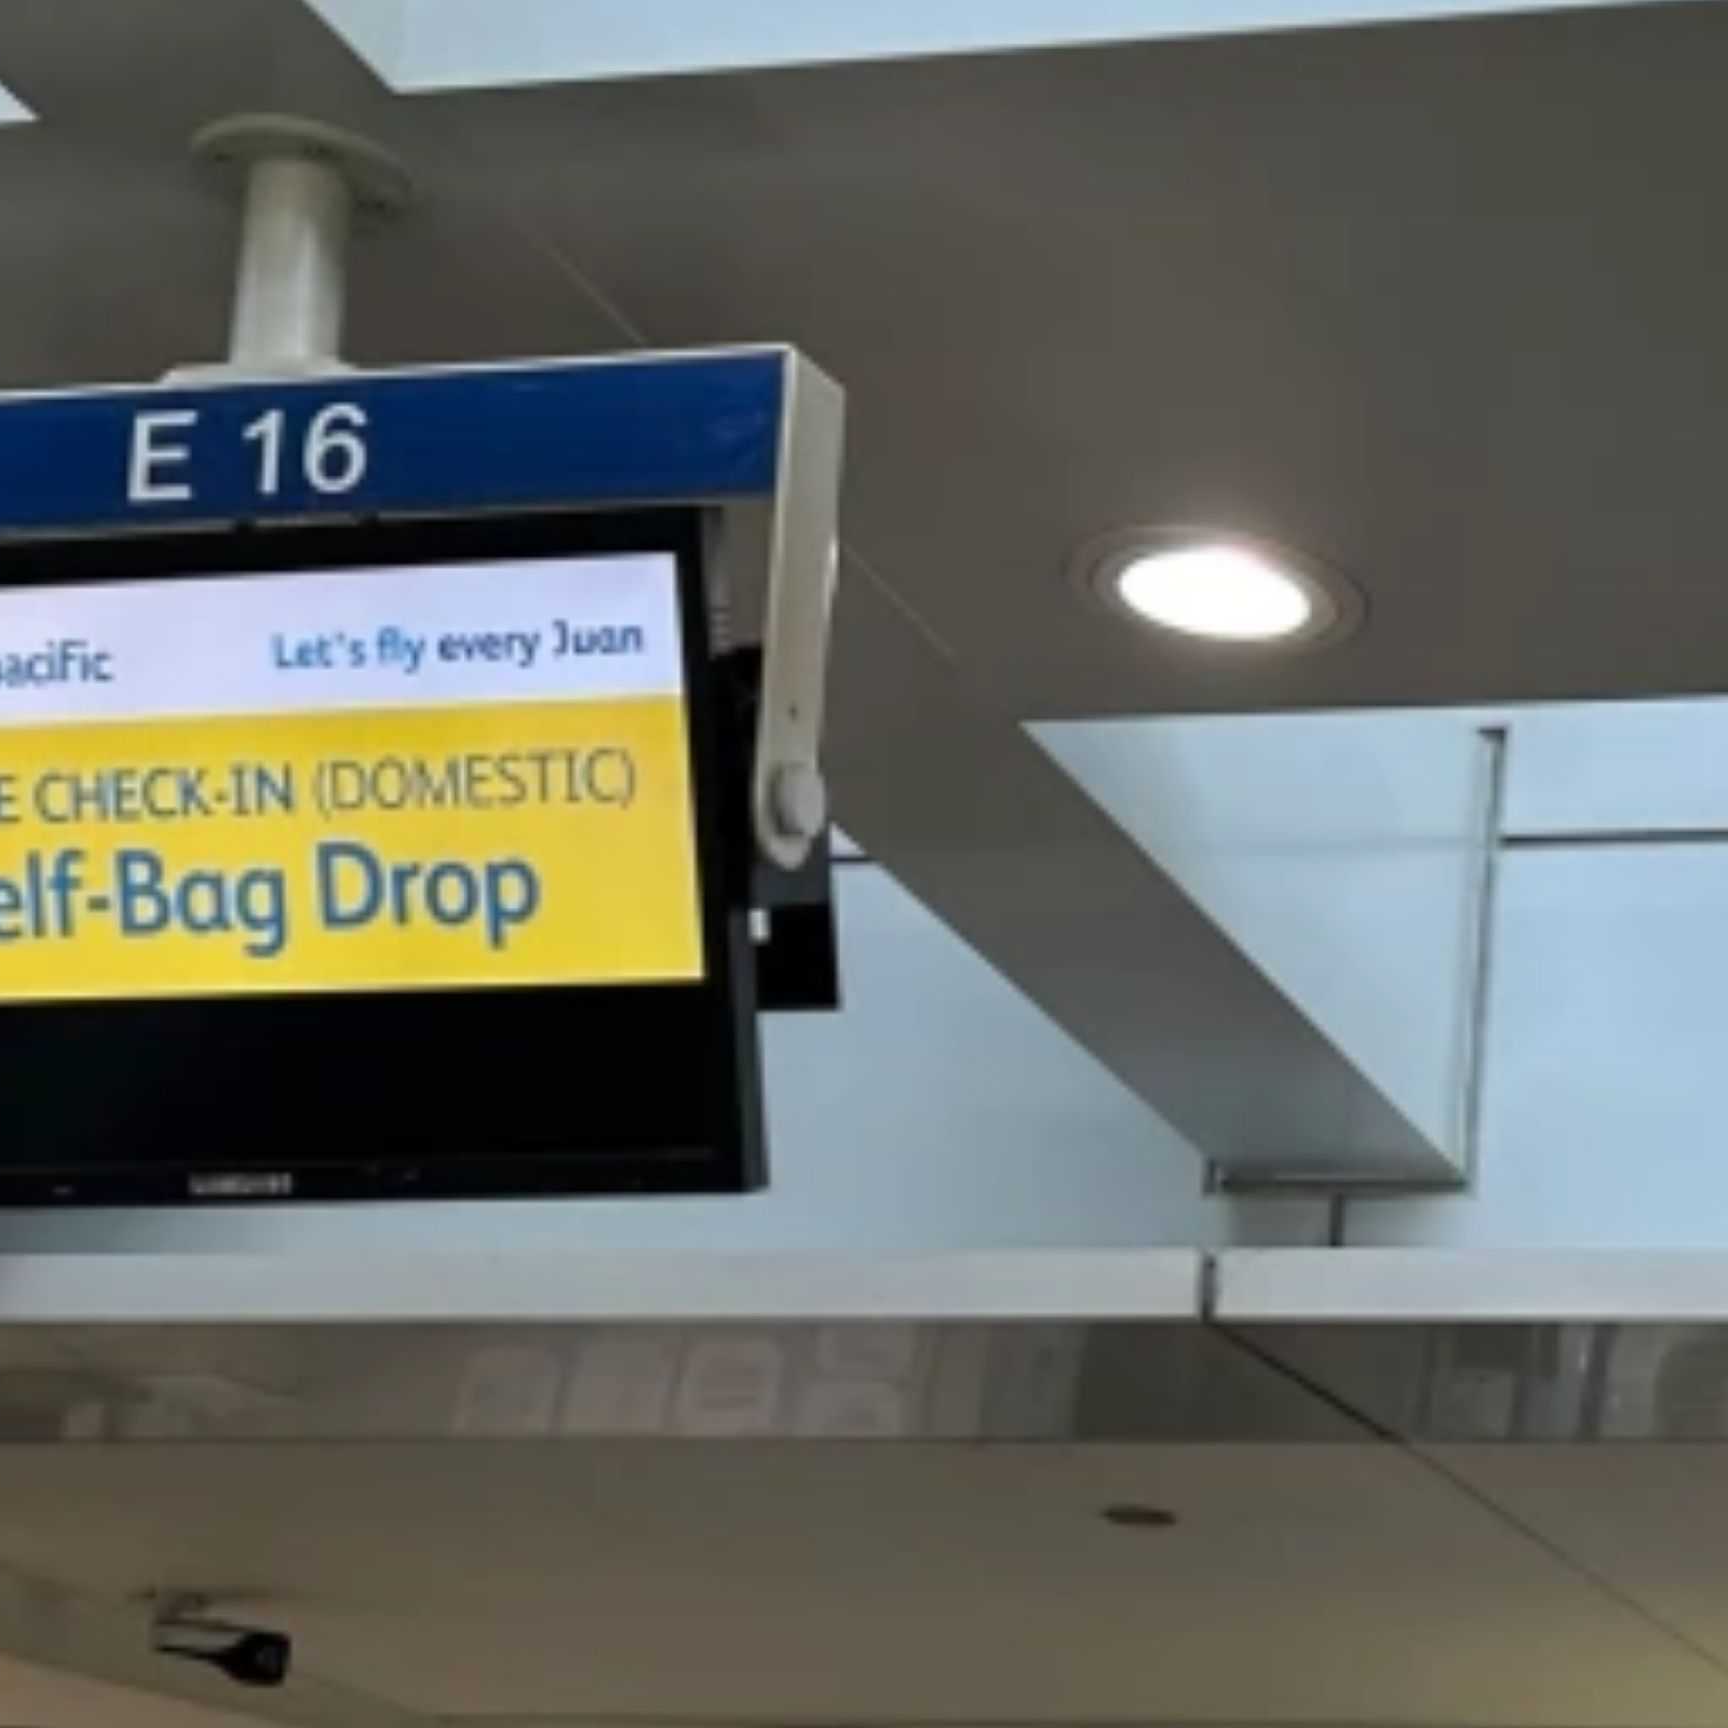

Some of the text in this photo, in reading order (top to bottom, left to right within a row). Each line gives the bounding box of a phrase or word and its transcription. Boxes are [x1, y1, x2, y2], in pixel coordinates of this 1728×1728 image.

[127, 401, 368, 502] E 16
[273, 617, 646, 675] Let's fly every Juan
[33, 763, 296, 827] CHECK-IN
[313, 747, 637, 818] (DOMESTIC)
[314, 840, 543, 952] Drop
